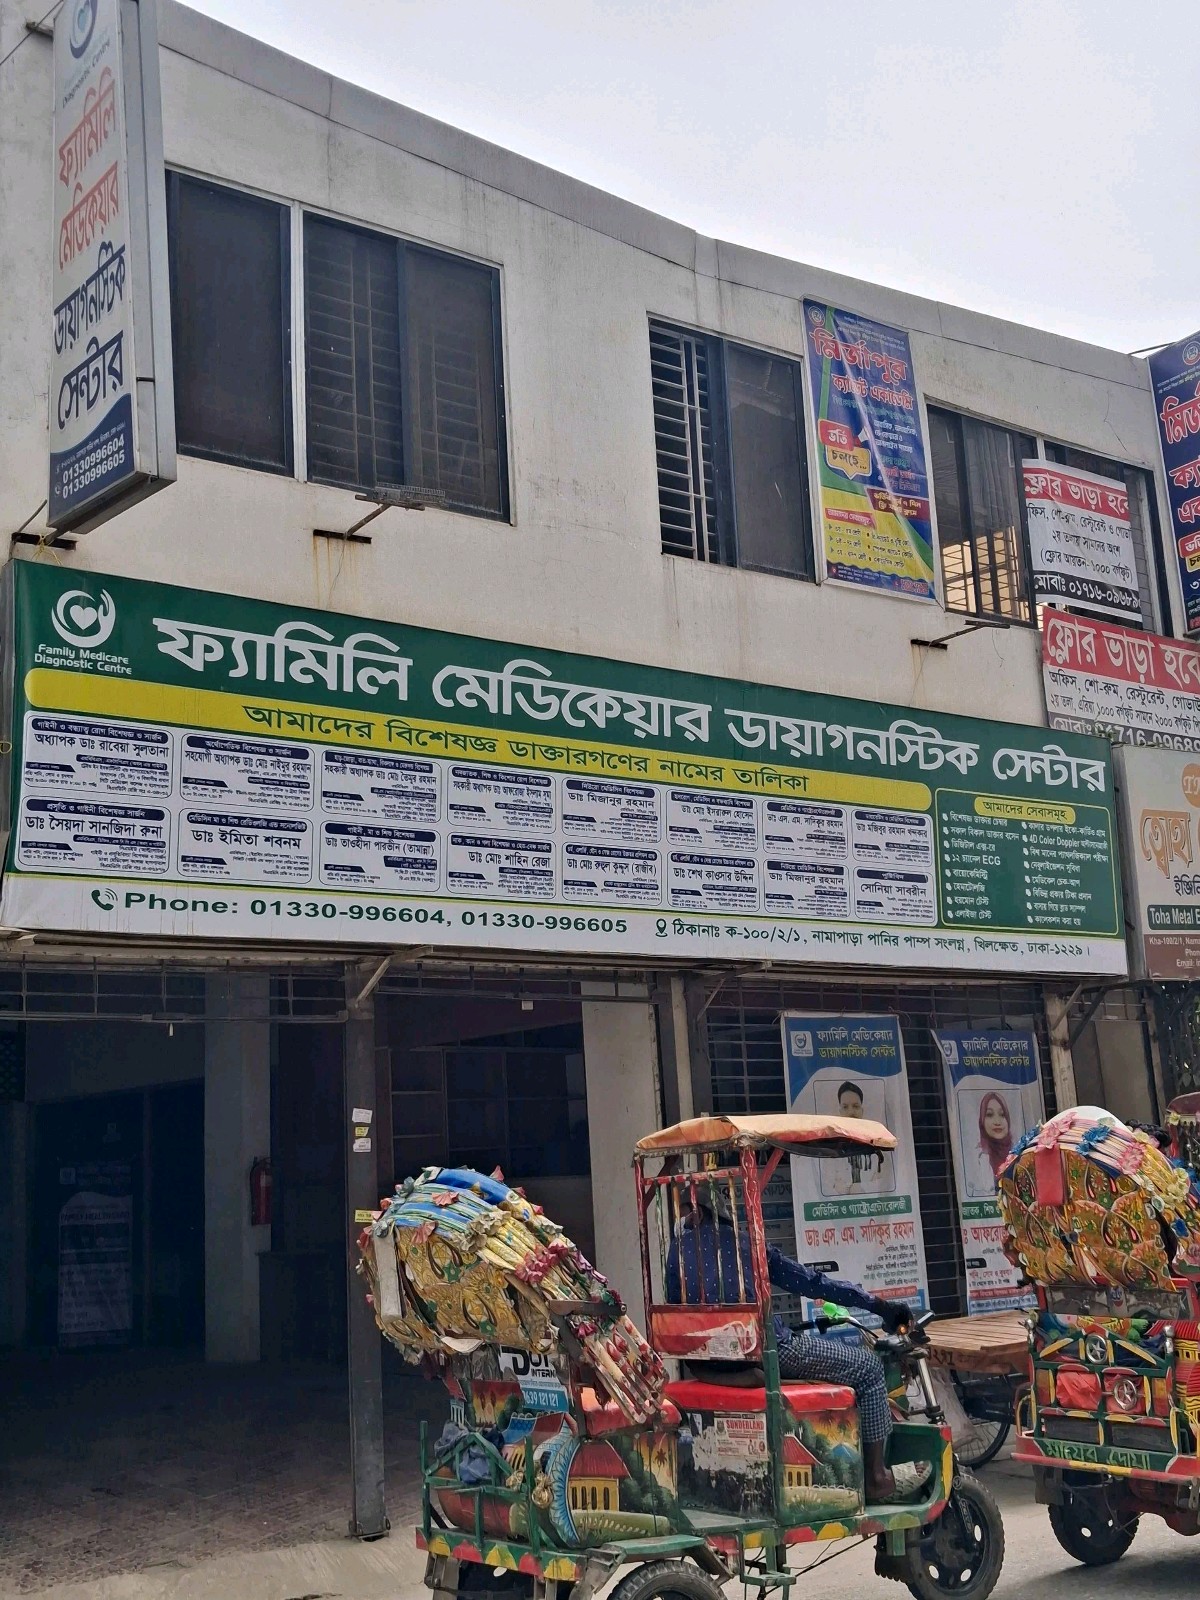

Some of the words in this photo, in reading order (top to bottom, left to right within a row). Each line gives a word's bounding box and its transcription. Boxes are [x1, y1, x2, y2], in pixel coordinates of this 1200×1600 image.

[59, 66, 116, 187] ফ্যামিলি
[59, 161, 119, 271] মেডিকেয়ার
[54, 240, 126, 354] ডায়াগনস্টিক
[58, 330, 123, 430] সেন্টার
[828, 429, 848, 444] ভর্তি
[63, 434, 124, 483] 01330996604
[63, 450, 125, 498] 01330996605
[1066, 480, 1102, 510] ভাড়া
[34, 653, 93, 669] Diagnostic
[97, 662, 132, 674] Centre
[38, 644, 75, 658] Family
[80, 649, 129, 664] Medicare
[1047, 618, 1097, 666] ফ্লোর
[1101, 631, 1155, 683] ভাড়া
[1159, 644, 1200, 689] হবে
[1049, 669, 1081, 693] অফিস,
[153, 617, 414, 702] ফ্যামিলি
[431, 658, 711, 744] মেডিকেয়ার
[725, 707, 980, 776] ডায়াগনস্টিক
[992, 744, 1106, 792] সেন্টার
[34, 734, 76, 747] অধ্যাপক
[79, 738, 95, 749] ডাঃ
[98, 740, 129, 754] রাবেয়া
[133, 743, 169, 758] সুলতানা
[241, 703, 375, 741] আমাদের
[384, 717, 497, 755] বিশেষজ্ঞ
[508, 735, 650, 775] ডাক্তারগণের
[660, 759, 724, 783] নামের
[733, 767, 810, 792] তালিকা
[185, 749, 212, 763] সহযোগী
[214, 754, 241, 765] অধ্যাপক
[243, 758, 253, 767] ডাঃ
[255, 758, 267, 769] মোঃ
[292, 762, 311, 773] রহমান
[324, 763, 347, 776] সহকারী
[350, 767, 374, 778] অধ্যাপক
[376, 770, 385, 779] ডাঃ
[418, 775, 437, 785] রহমান
[568, 792, 584, 802] ডাঃ
[587, 792, 622, 807] মিজানুর
[625, 799, 655, 808] রহমান
[767, 814, 776, 822] ডাঃ
[983, 802, 1023, 814] আমাদের
[1027, 807, 1067, 821] সেবাসমূহ
[25, 816, 45, 829] ডাঃ
[49, 814, 84, 832] সৈয়দা
[89, 819, 136, 836] সানজিদা
[140, 825, 163, 839] রুনা
[191, 829, 213, 842] ডাঃ
[218, 828, 259, 846] ইমিতা
[263, 835, 302, 850] শবনম
[325, 837, 337, 846] ডাঃ
[340, 837, 371, 850] তাওহীদা
[374, 839, 401, 852] পারভীন
[468, 851, 482, 863] ডাঃ
[486, 853, 501, 864] মোঃ
[505, 852, 529, 867] শাহিন
[532, 857, 551, 868] রেজা
[567, 858, 577, 868] ডাঃ
[580, 859, 592, 870] মোঃ
[982, 855, 1000, 865] ECG
[673, 868, 685, 878] ডাঃ
[687, 868, 703, 879] শেখ
[785, 872, 815, 885] মিজানুর
[819, 876, 844, 885] রহমান
[861, 882, 892, 894] সোনিয়া
[896, 885, 926, 897] সাবরীন
[123, 890, 239, 915] Phone:
[248, 898, 454, 928] 01330-996604,
[461, 908, 627, 933] 01330-996605
[1150, 908, 1171, 924] Toha
[1172, 908, 1193, 924] Metal
[672, 918, 720, 938] ঠিকানাঃ
[811, 930, 863, 946] নামাপাড়া
[867, 930, 899, 947] পানির
[904, 936, 930, 949] পাম্প
[816, 1027, 848, 1042] ফ্যামিলি
[805, 1228, 819, 1247] ডাঃ
[893, 1222, 914, 1240] রহমান
[538, 1392, 548, 1406] 121
[549, 1393, 559, 1407] 121
[726, 1420, 764, 1430] SUNDERLAND
